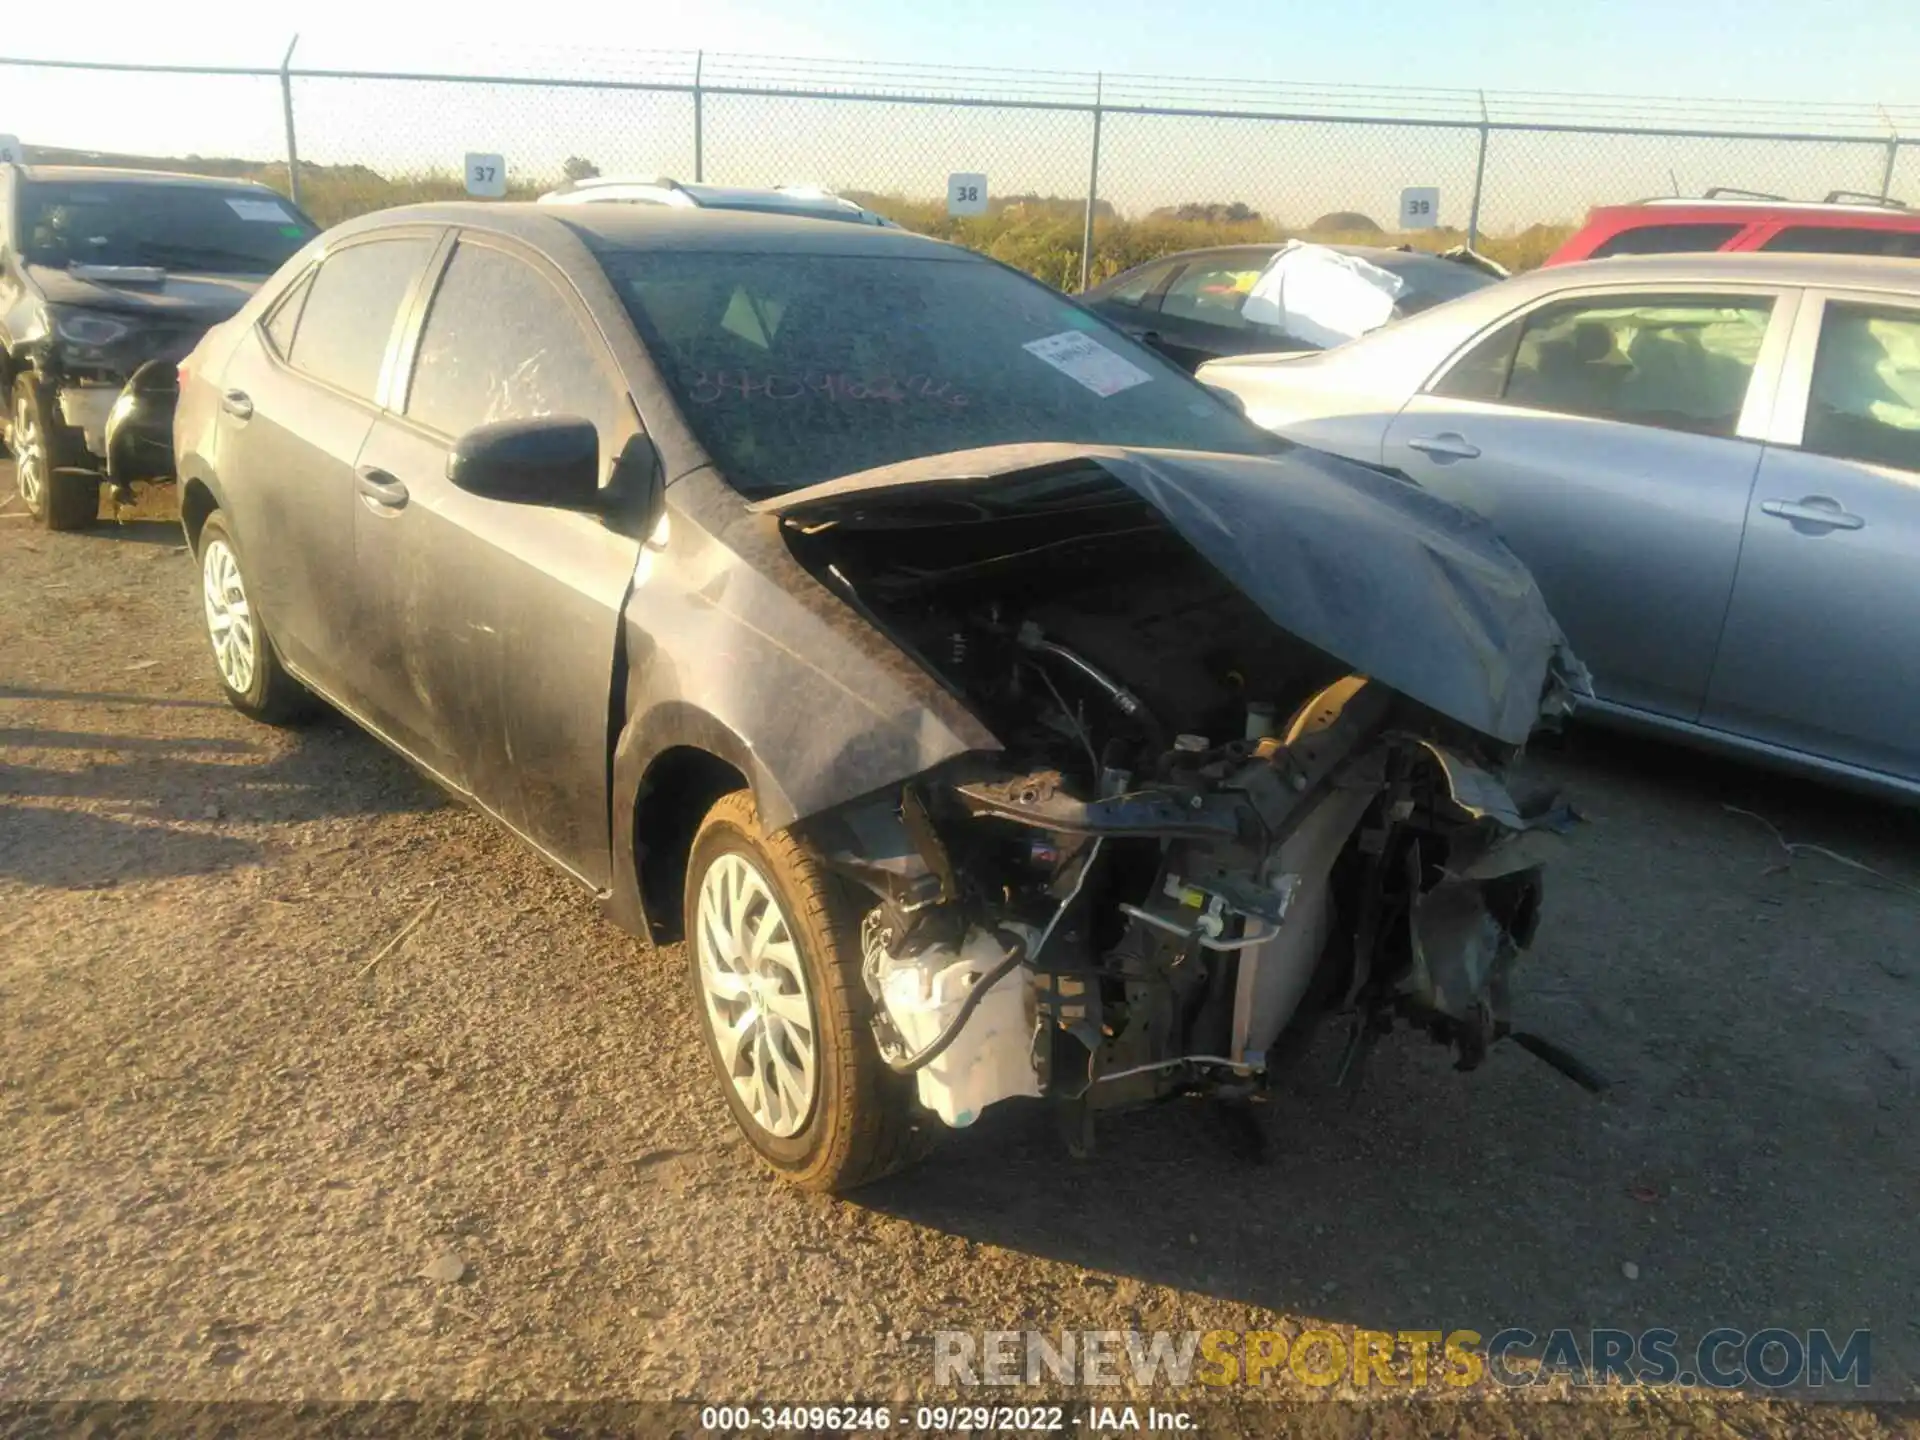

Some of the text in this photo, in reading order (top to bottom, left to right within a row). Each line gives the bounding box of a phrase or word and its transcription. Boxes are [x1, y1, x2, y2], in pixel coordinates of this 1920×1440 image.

[474, 166, 495, 182] 37
[956, 186, 978, 203] 38
[1408, 200, 1430, 216] 39
